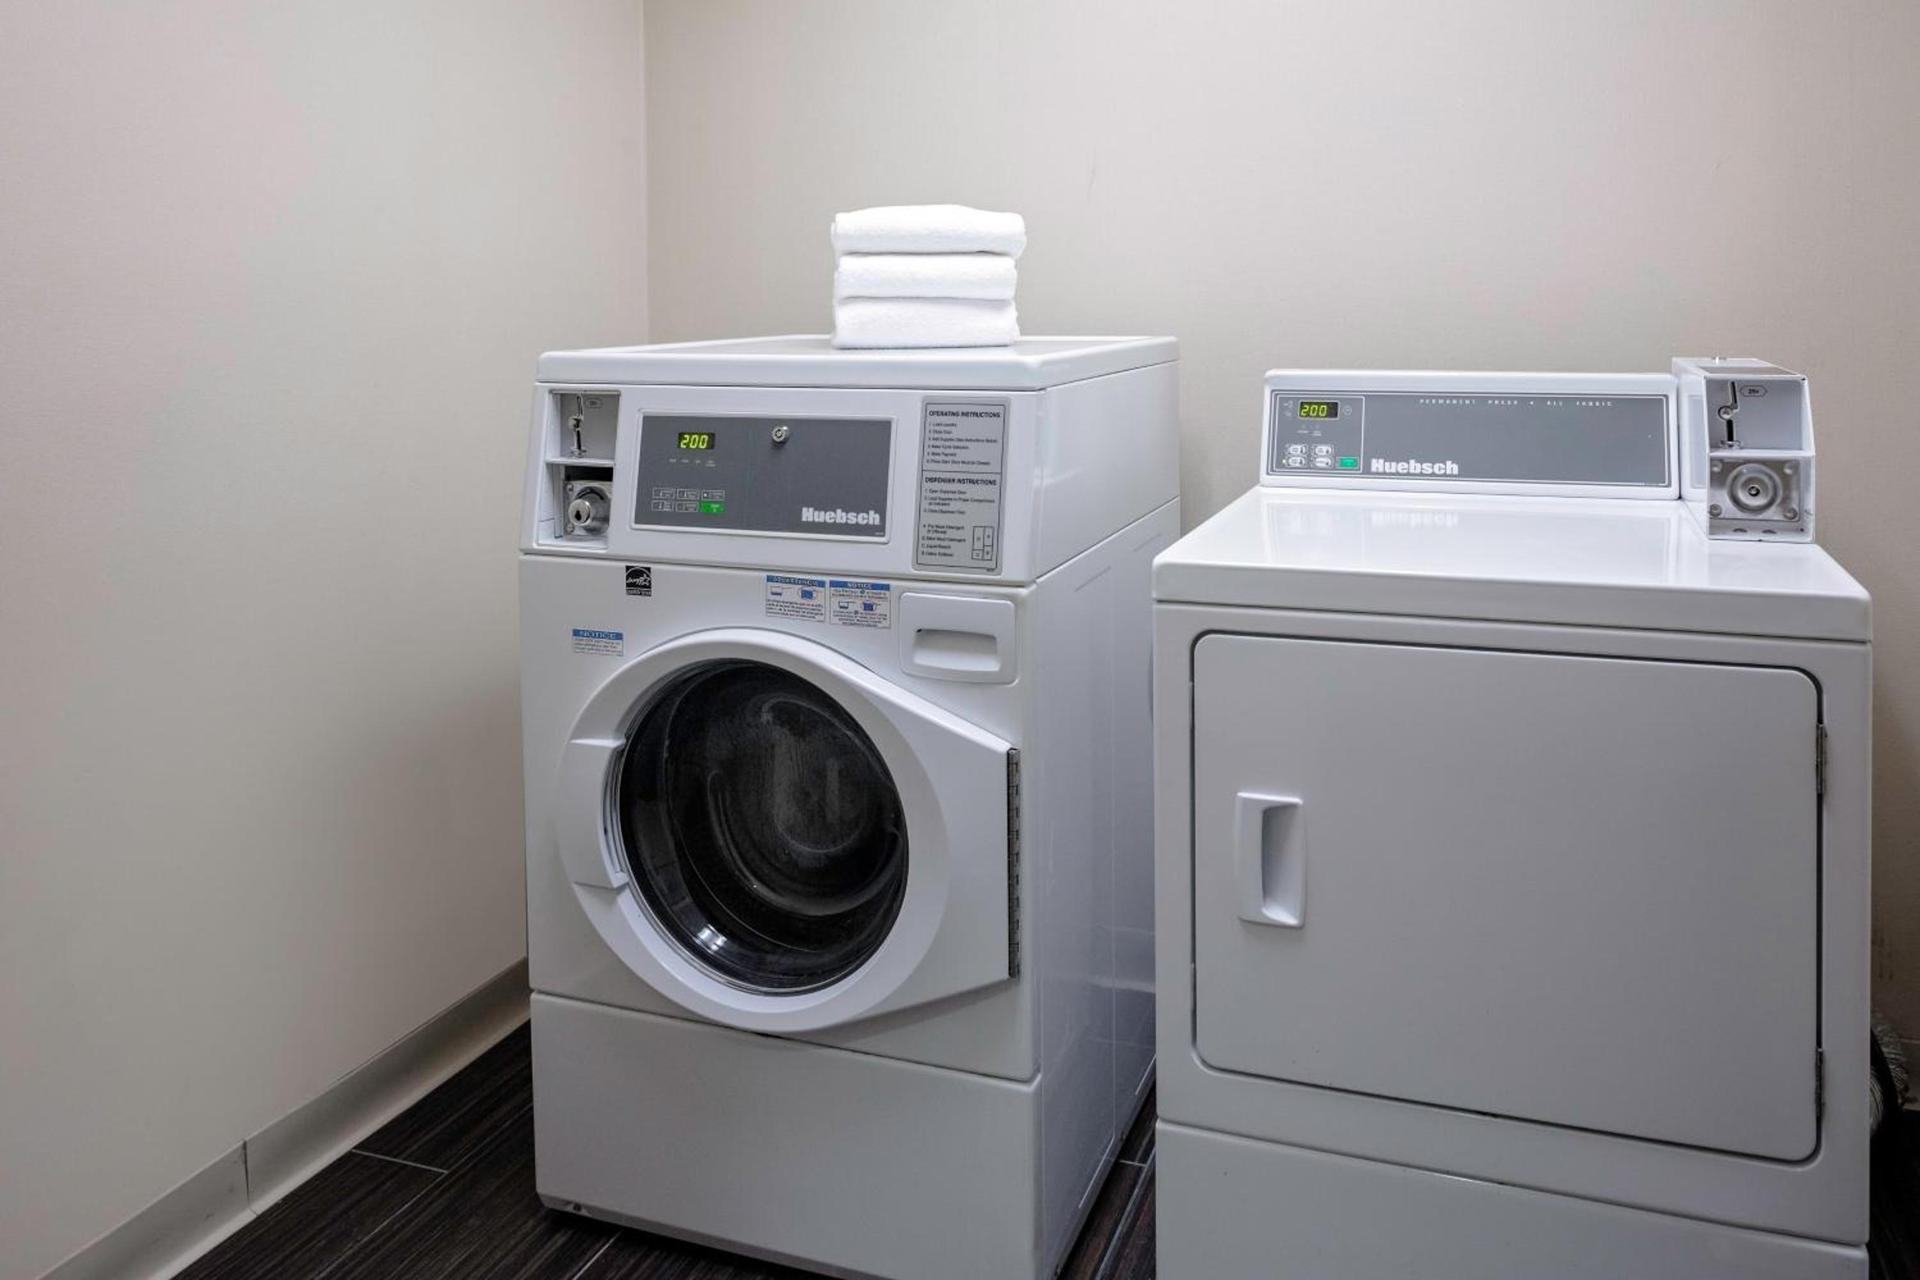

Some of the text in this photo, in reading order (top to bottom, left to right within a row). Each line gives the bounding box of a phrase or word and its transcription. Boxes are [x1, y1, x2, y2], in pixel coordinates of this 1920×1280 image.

[961, 410, 1001, 418] INSTRUCTIONS
[1300, 404, 1328, 417] 200
[680, 434, 709, 449] 200
[1370, 458, 1459, 475] Huebsch
[957, 477, 997, 486] INSTRUCTIONS
[801, 507, 881, 525] Huebsch
[579, 630, 617, 640] NOTICE
